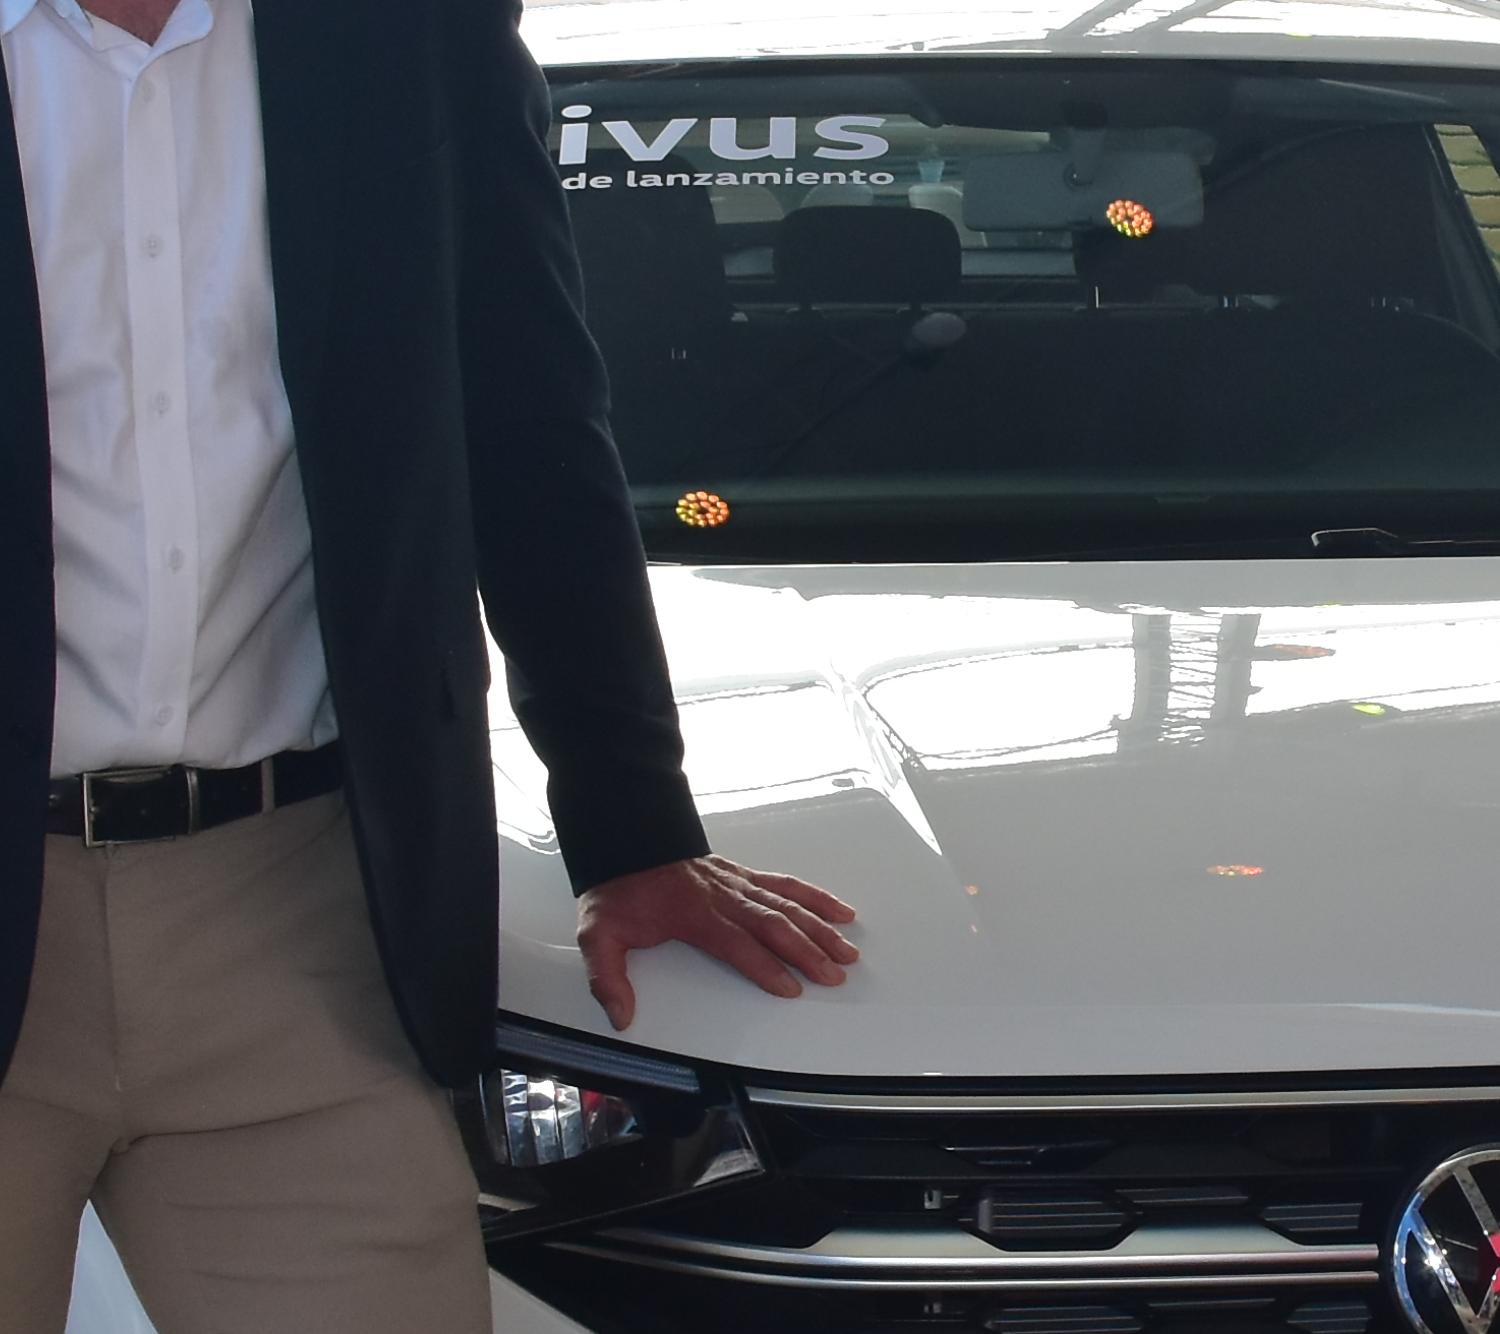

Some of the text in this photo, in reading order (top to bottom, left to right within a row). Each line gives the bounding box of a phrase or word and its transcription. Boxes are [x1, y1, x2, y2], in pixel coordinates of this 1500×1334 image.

[558, 105, 890, 165] ivus
[561, 167, 895, 190] de lanzamiento
